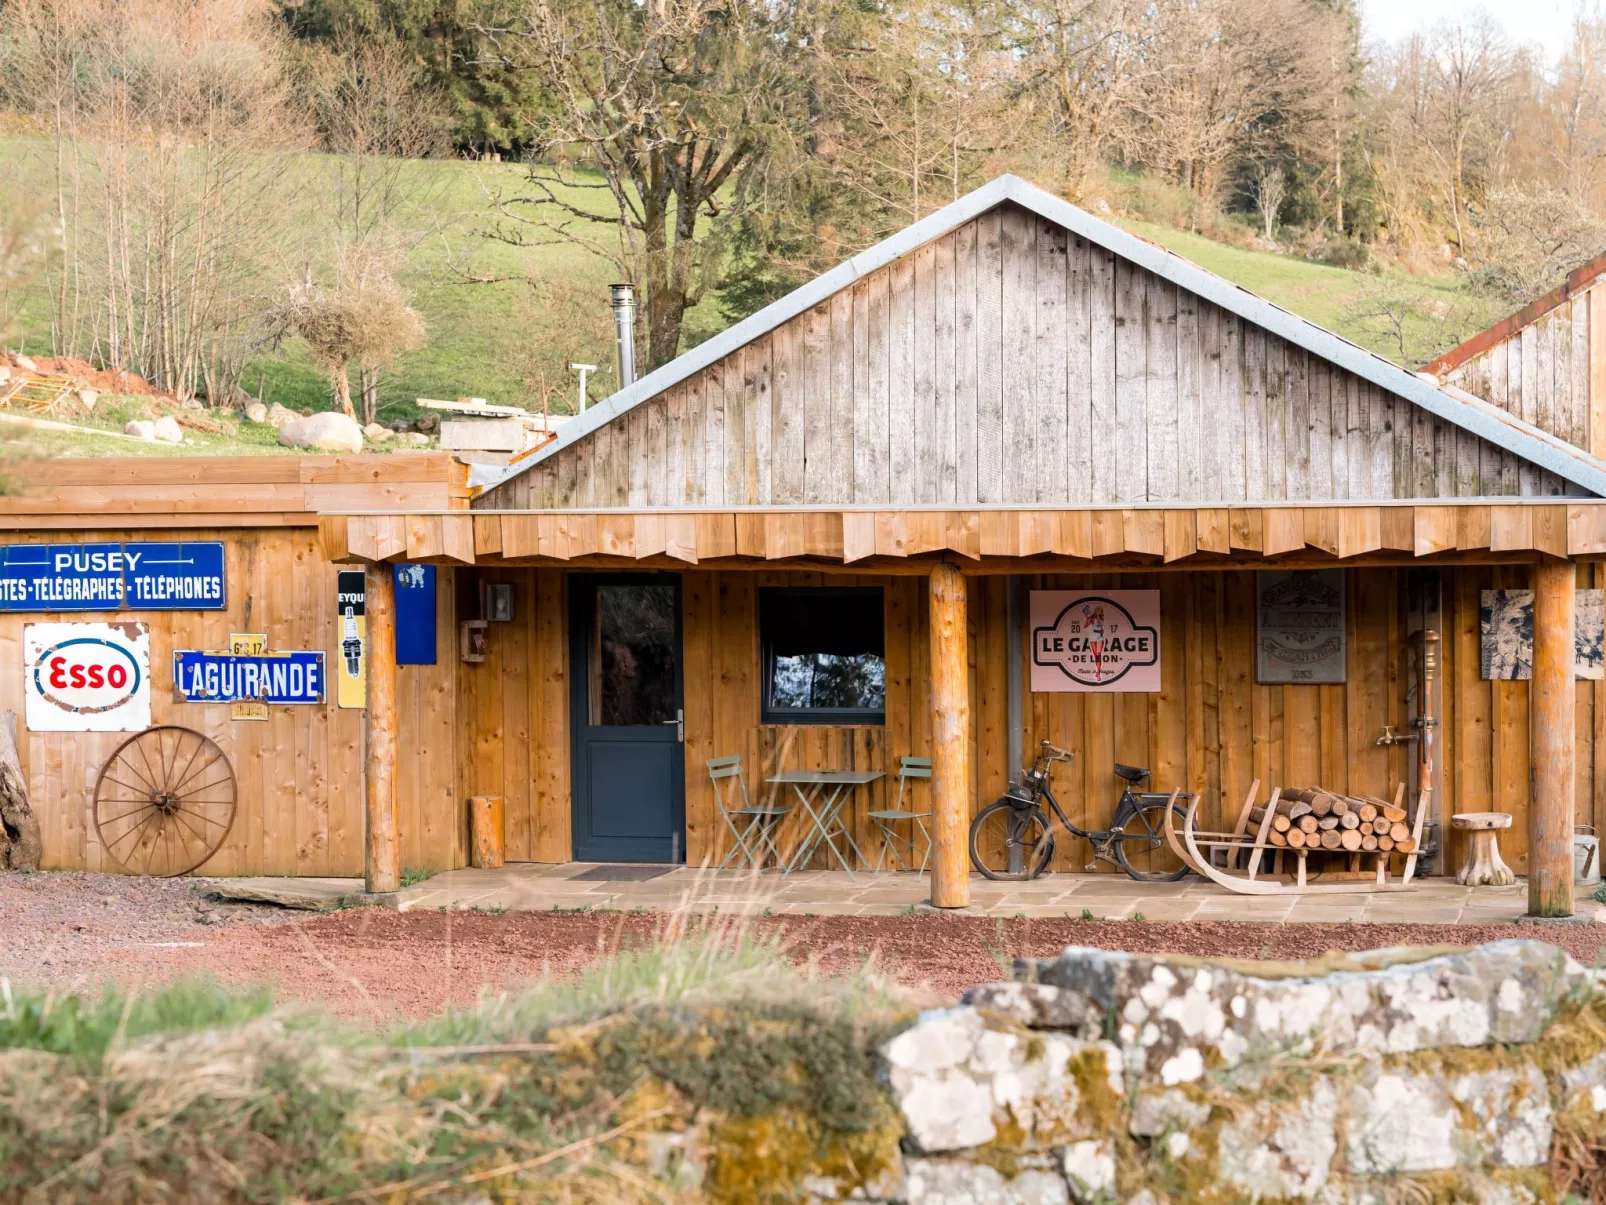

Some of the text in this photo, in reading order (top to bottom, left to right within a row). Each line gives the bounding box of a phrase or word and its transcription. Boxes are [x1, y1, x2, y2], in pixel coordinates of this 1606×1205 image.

[55, 552, 142, 572] PUSEY
[1071, 624, 1081, 633] 20
[1110, 624, 1118, 633] 17
[1043, 638, 1064, 652] LE
[1072, 655, 1087, 663] DE
[178, 662, 318, 697] LAGUIRANDE
